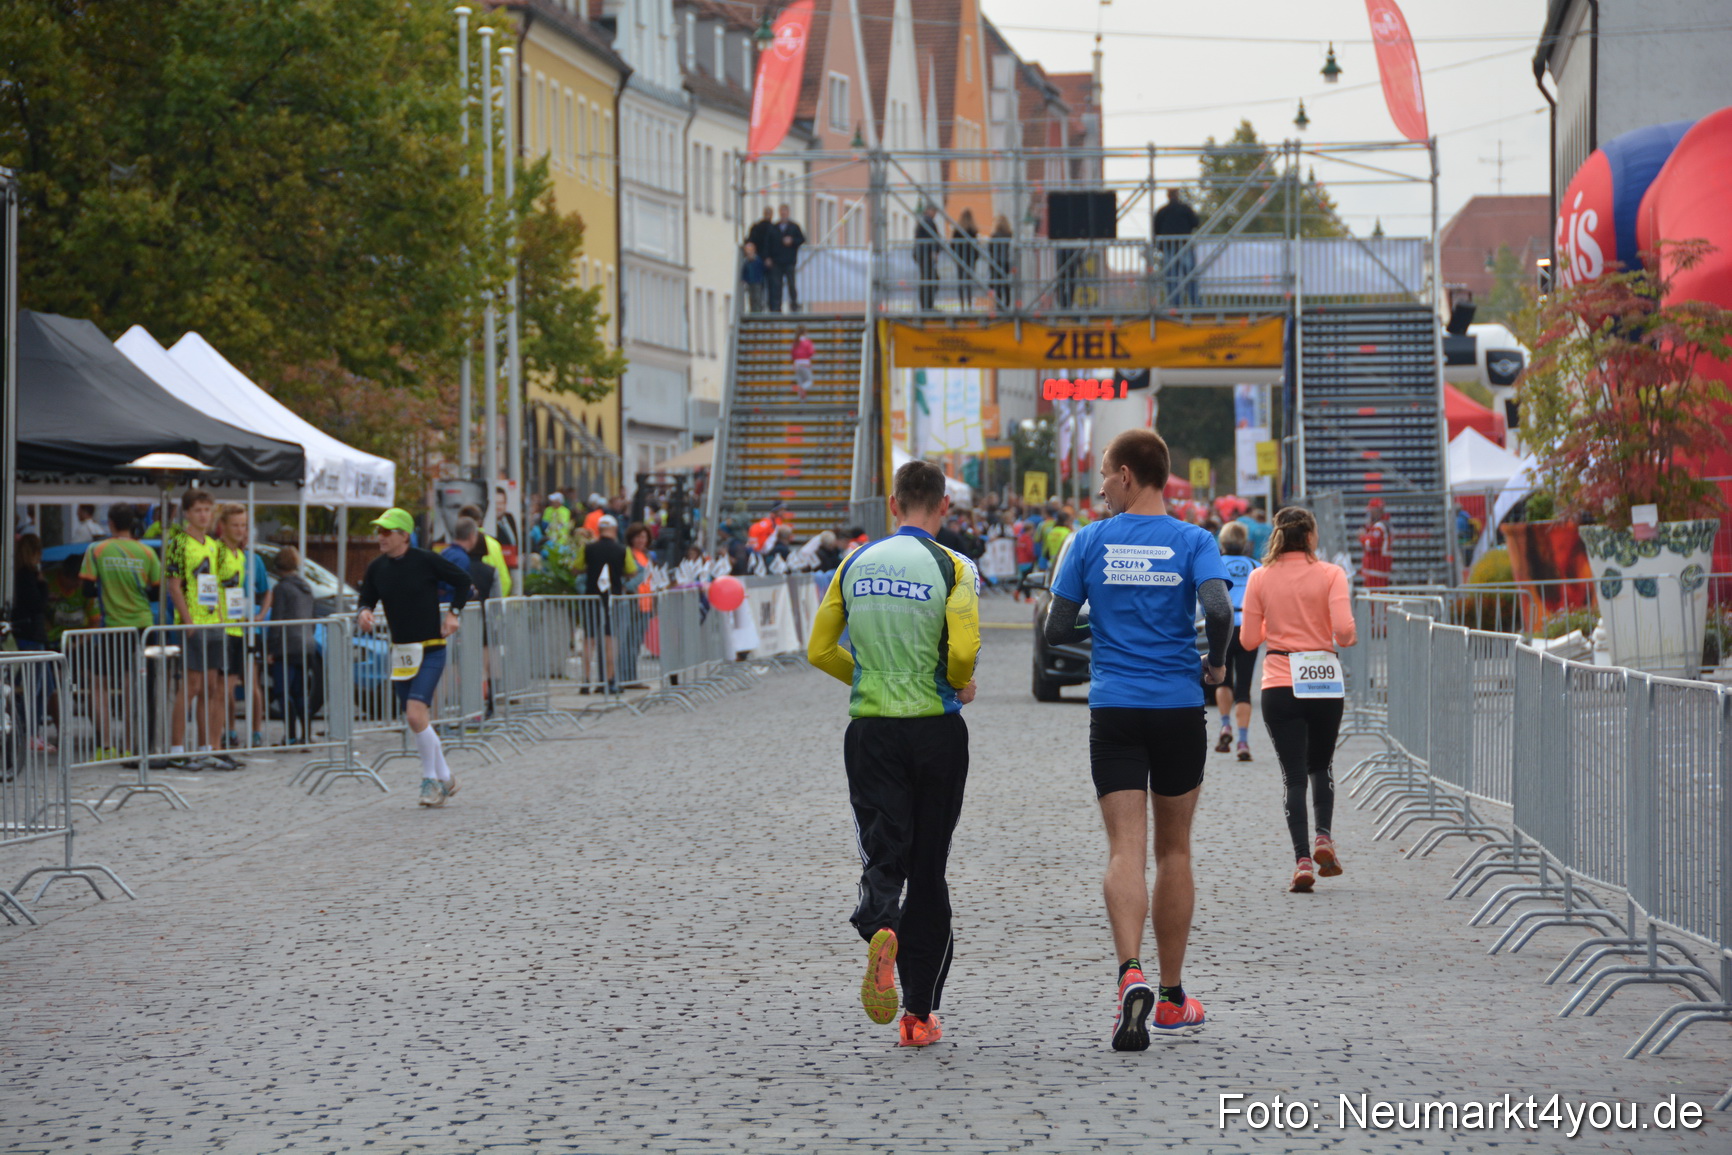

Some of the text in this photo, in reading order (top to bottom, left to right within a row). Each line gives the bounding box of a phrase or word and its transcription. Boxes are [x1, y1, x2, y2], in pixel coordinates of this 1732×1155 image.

[1045, 331, 1131, 360] ZIEL
[1029, 482, 1041, 496] A
[857, 563, 906, 577] TEAM
[1111, 560, 1133, 569] CSU
[1111, 573, 1176, 583] RICHARD GRAF
[853, 578, 933, 601] BOCK
[401, 655, 413, 666] 18
[1299, 665, 1335, 680] 2699
